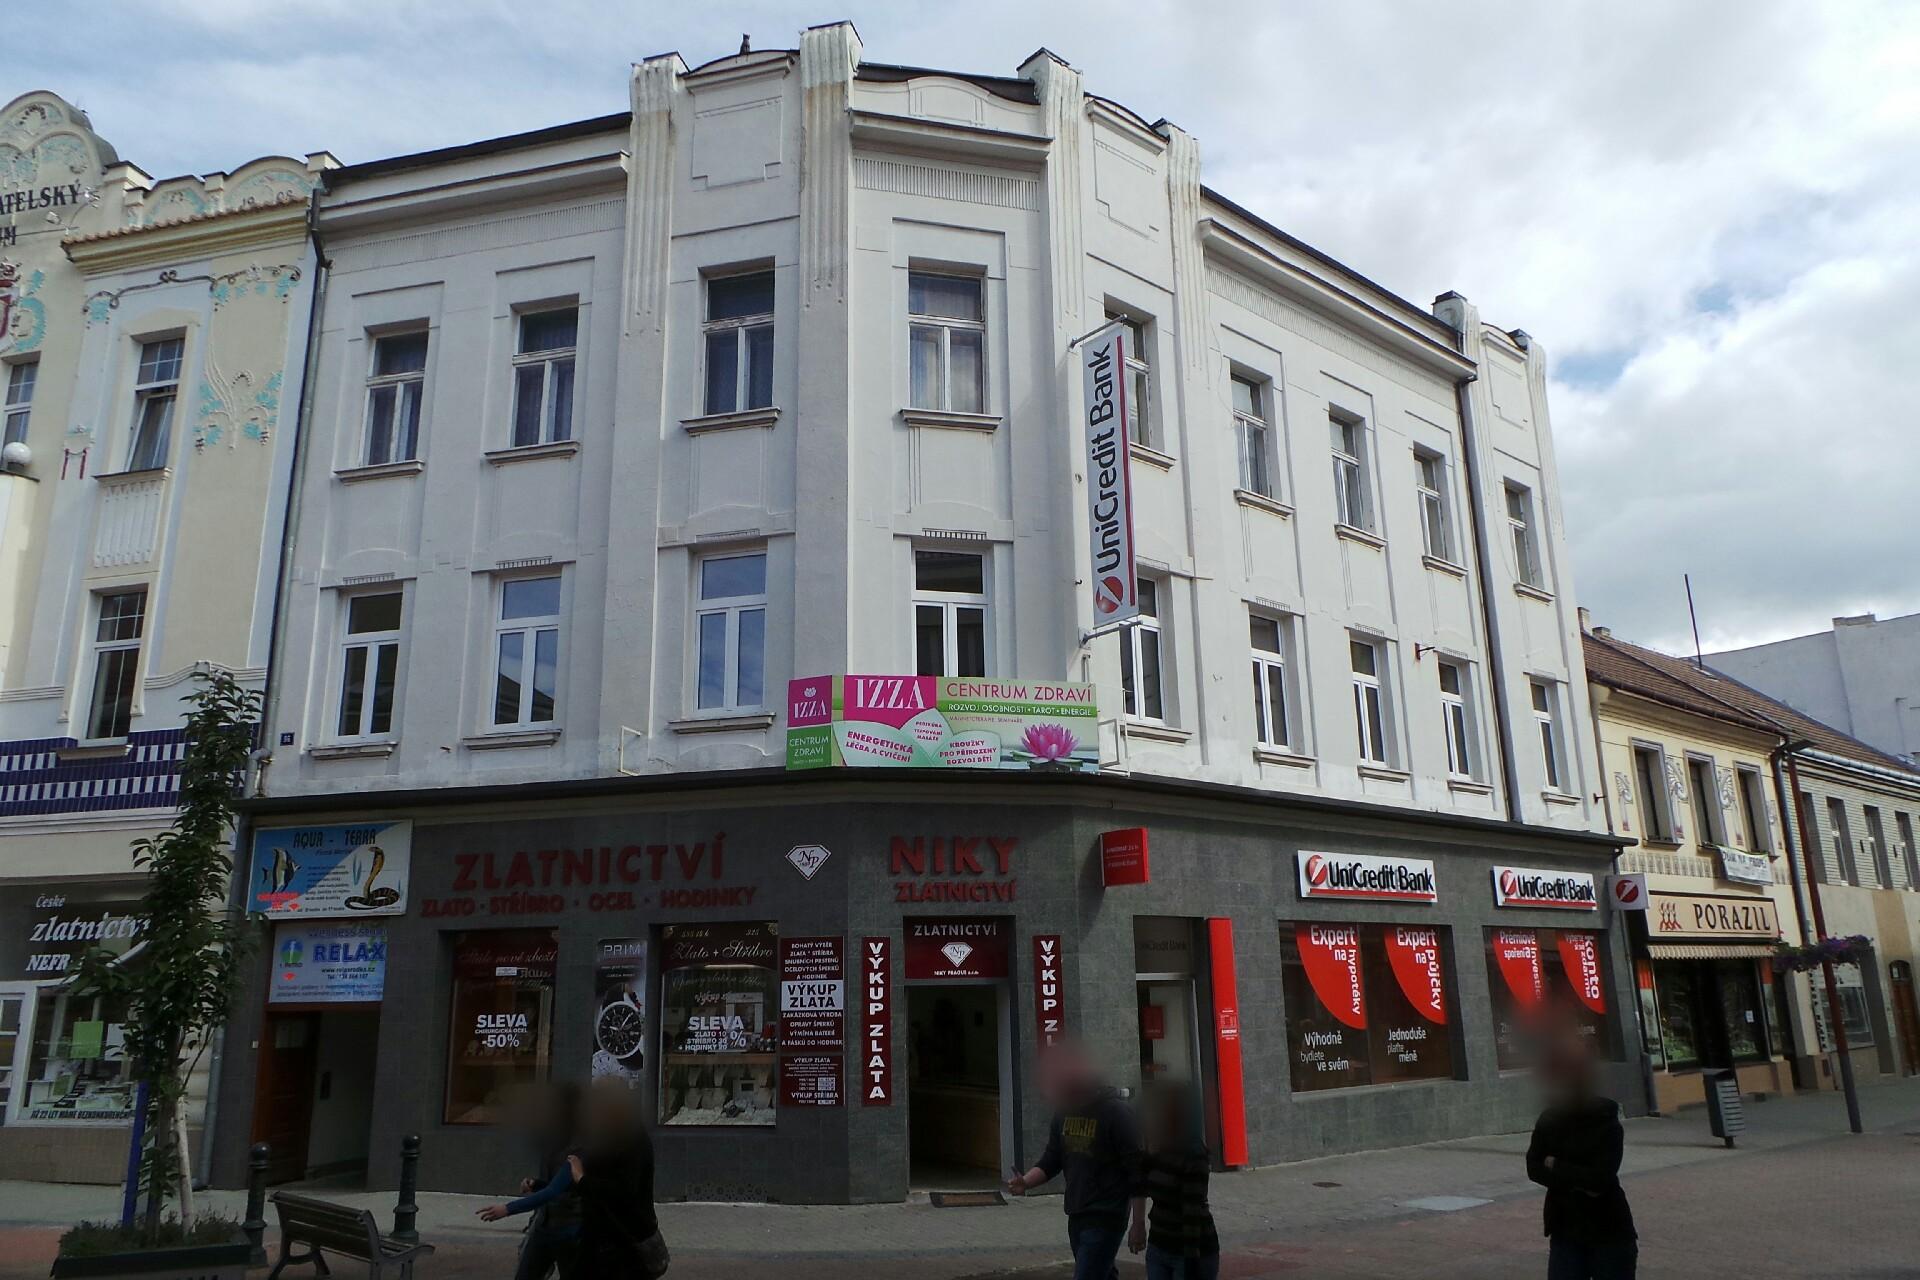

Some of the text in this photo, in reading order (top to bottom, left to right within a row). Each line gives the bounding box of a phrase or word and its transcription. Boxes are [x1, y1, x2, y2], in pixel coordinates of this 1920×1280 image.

[1087, 342, 1121, 574] UniCredit Bank
[854, 678, 927, 709] IZZA
[946, 682, 1092, 702] CENTRUM ZDRAVÍ
[794, 700, 827, 719] IZZA
[948, 703, 979, 712] ROZVOJ
[982, 704, 1027, 714] OSOBNOSTI
[1033, 706, 1056, 715] TAROT
[789, 735, 829, 747] CENTRUM
[847, 730, 914, 754] ENERGETICKÁ
[950, 740, 985, 748] KROUŽKY
[794, 746, 824, 757] ZDRAVÍ
[845, 739, 870, 753] LÉČBA
[879, 748, 912, 763] CVIČENÍ
[939, 750, 955, 758] PRO
[946, 755, 993, 765] ROZVOJ DĚTÍ
[293, 831, 324, 849] AQUA
[344, 828, 376, 846] TERRA
[452, 831, 727, 892] ZLATNICTVÍ
[890, 836, 1019, 874] NIKY
[1329, 860, 1435, 891] UniCredit Bank
[896, 880, 1017, 902] ZLATNICTVÍ
[1517, 874, 1596, 901] UniCredit Bank
[420, 886, 758, 918] ZLATO STŘÍBRO OCEL HODINKY
[1693, 903, 1771, 931] PORAZIL
[914, 921, 998, 937] ZLATNICTVÍ
[1310, 925, 1357, 950] Expert
[1397, 927, 1437, 950] Expert
[1500, 930, 1536, 945] Prémiové
[312, 942, 385, 963] RELAX
[604, 944, 640, 955] PRIM
[721, 940, 773, 959] Stříbro
[1334, 949, 1347, 961] na
[1416, 952, 1427, 964] na
[1040, 940, 1057, 1012] VÝKUP
[1580, 950, 1591, 998] zdarma
[1584, 935, 1600, 999] konto
[788, 983, 837, 995] VÝKUP
[1348, 949, 1361, 1015] hypotéky
[1425, 949, 1441, 1011] půjčky
[790, 997, 835, 1008] ZLATA
[476, 1014, 528, 1028] SLEVA
[688, 1016, 745, 1030] SLEVA
[869, 942, 885, 1099] VÝKUP ZLATA
[482, 1034, 520, 1047] -50%
[1304, 1031, 1343, 1049] Výhodně
[1388, 1027, 1427, 1041] Jednoduše
[1316, 1057, 1349, 1072] ve svém
[1399, 1051, 1418, 1063] méně
